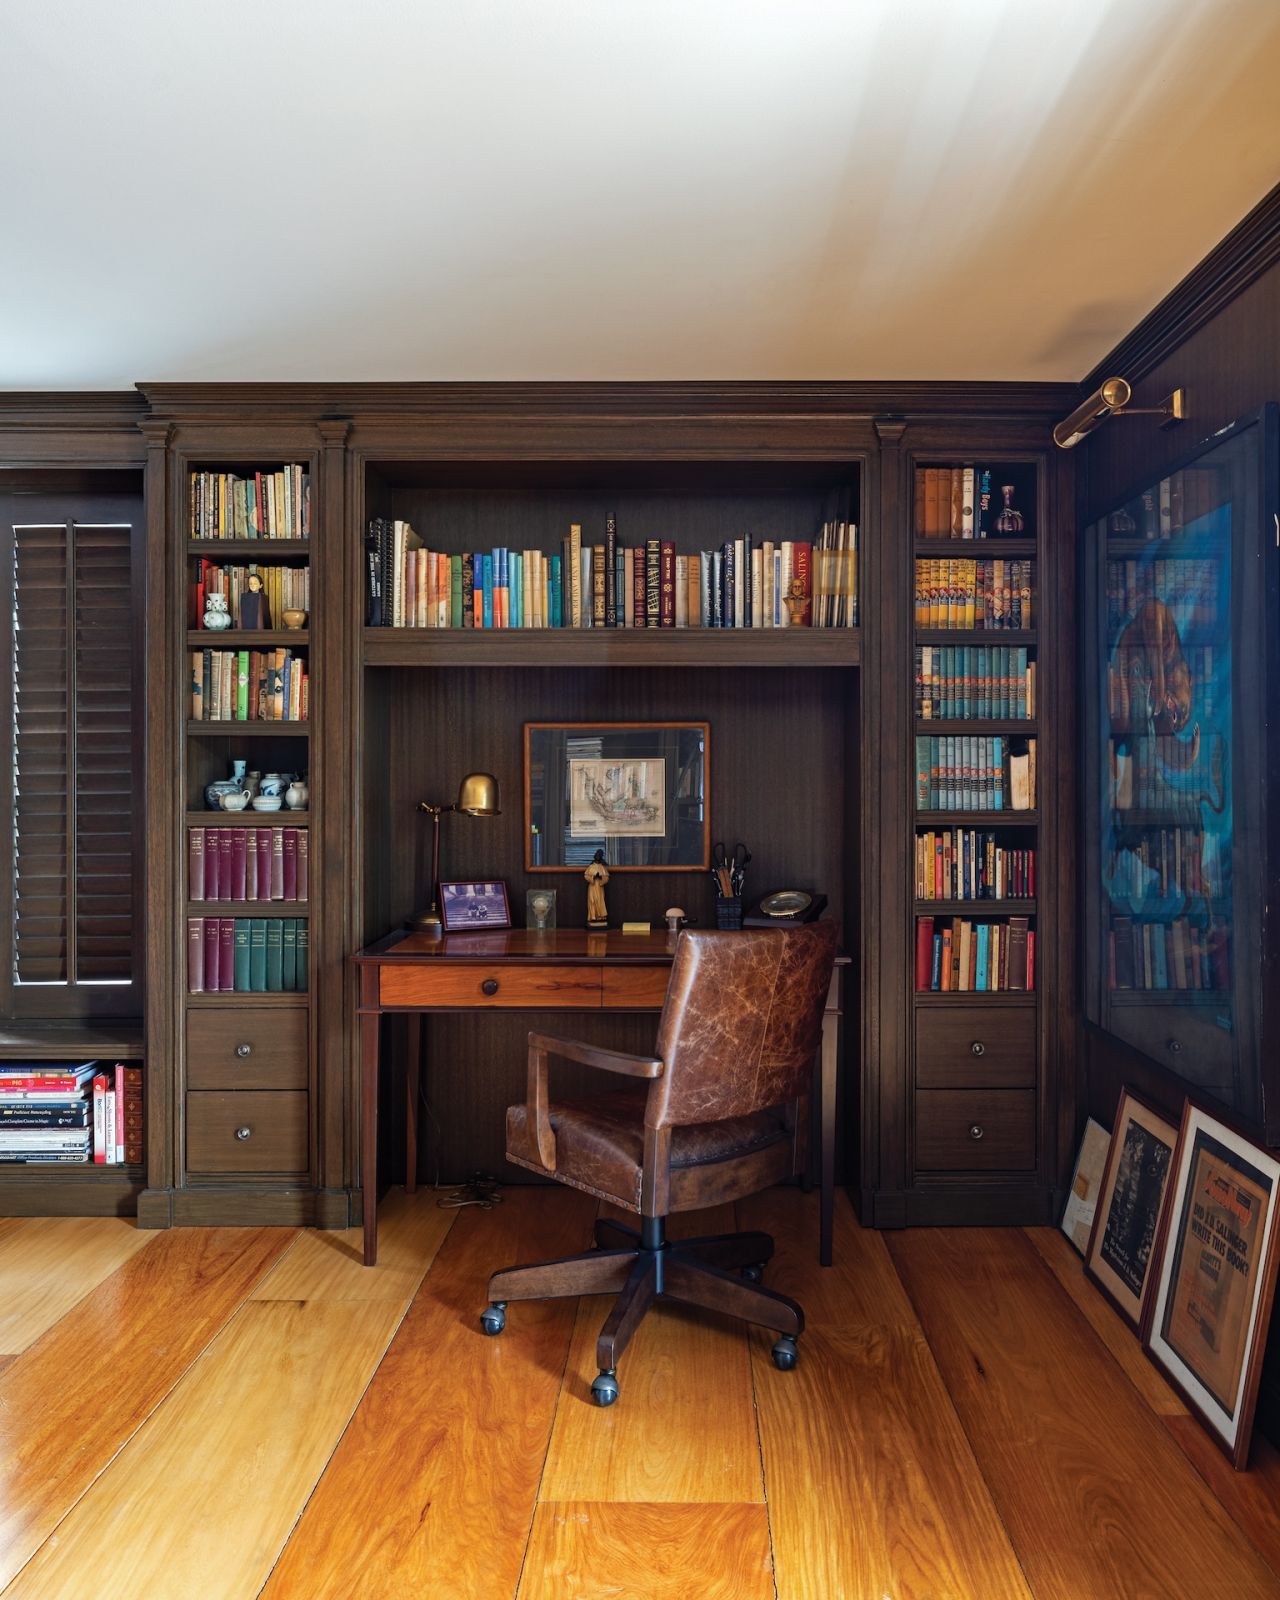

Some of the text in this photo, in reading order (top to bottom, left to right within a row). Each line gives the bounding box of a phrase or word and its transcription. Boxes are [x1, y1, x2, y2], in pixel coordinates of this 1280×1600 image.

[980, 494, 990, 511] Boys
[1191, 1219, 1212, 1245] WRITE
[1211, 1234, 1225, 1257] THIS
[1226, 1247, 1250, 1279] BOOK?
[1215, 1219, 1248, 1259] SALINGER
